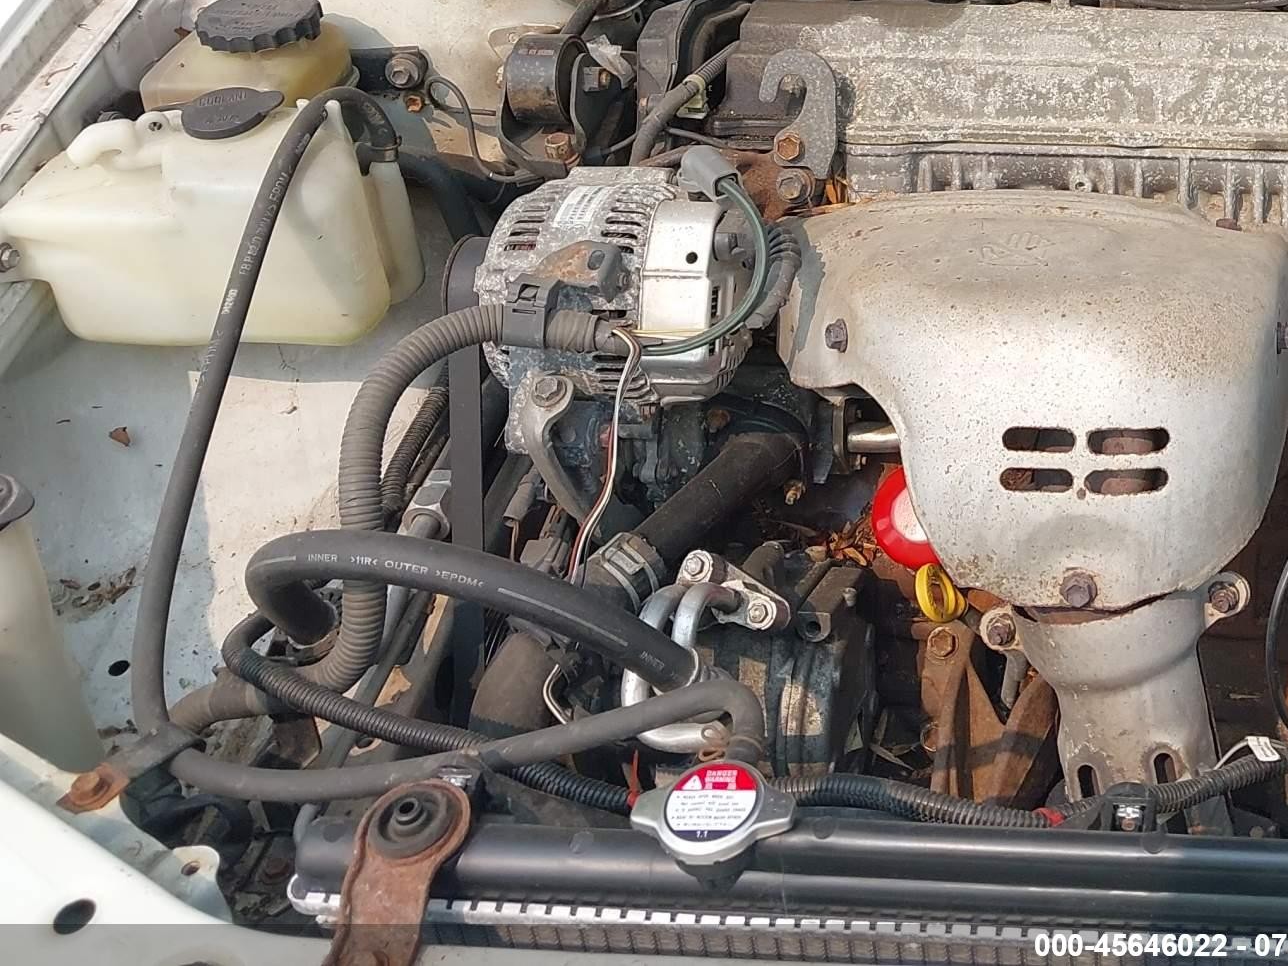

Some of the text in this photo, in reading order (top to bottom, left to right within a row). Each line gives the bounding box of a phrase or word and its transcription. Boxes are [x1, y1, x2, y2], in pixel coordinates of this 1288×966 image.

[308, 553, 338, 563] INNER
[384, 560, 429, 575] OUTER
[696, 830, 708, 839] 1.1
